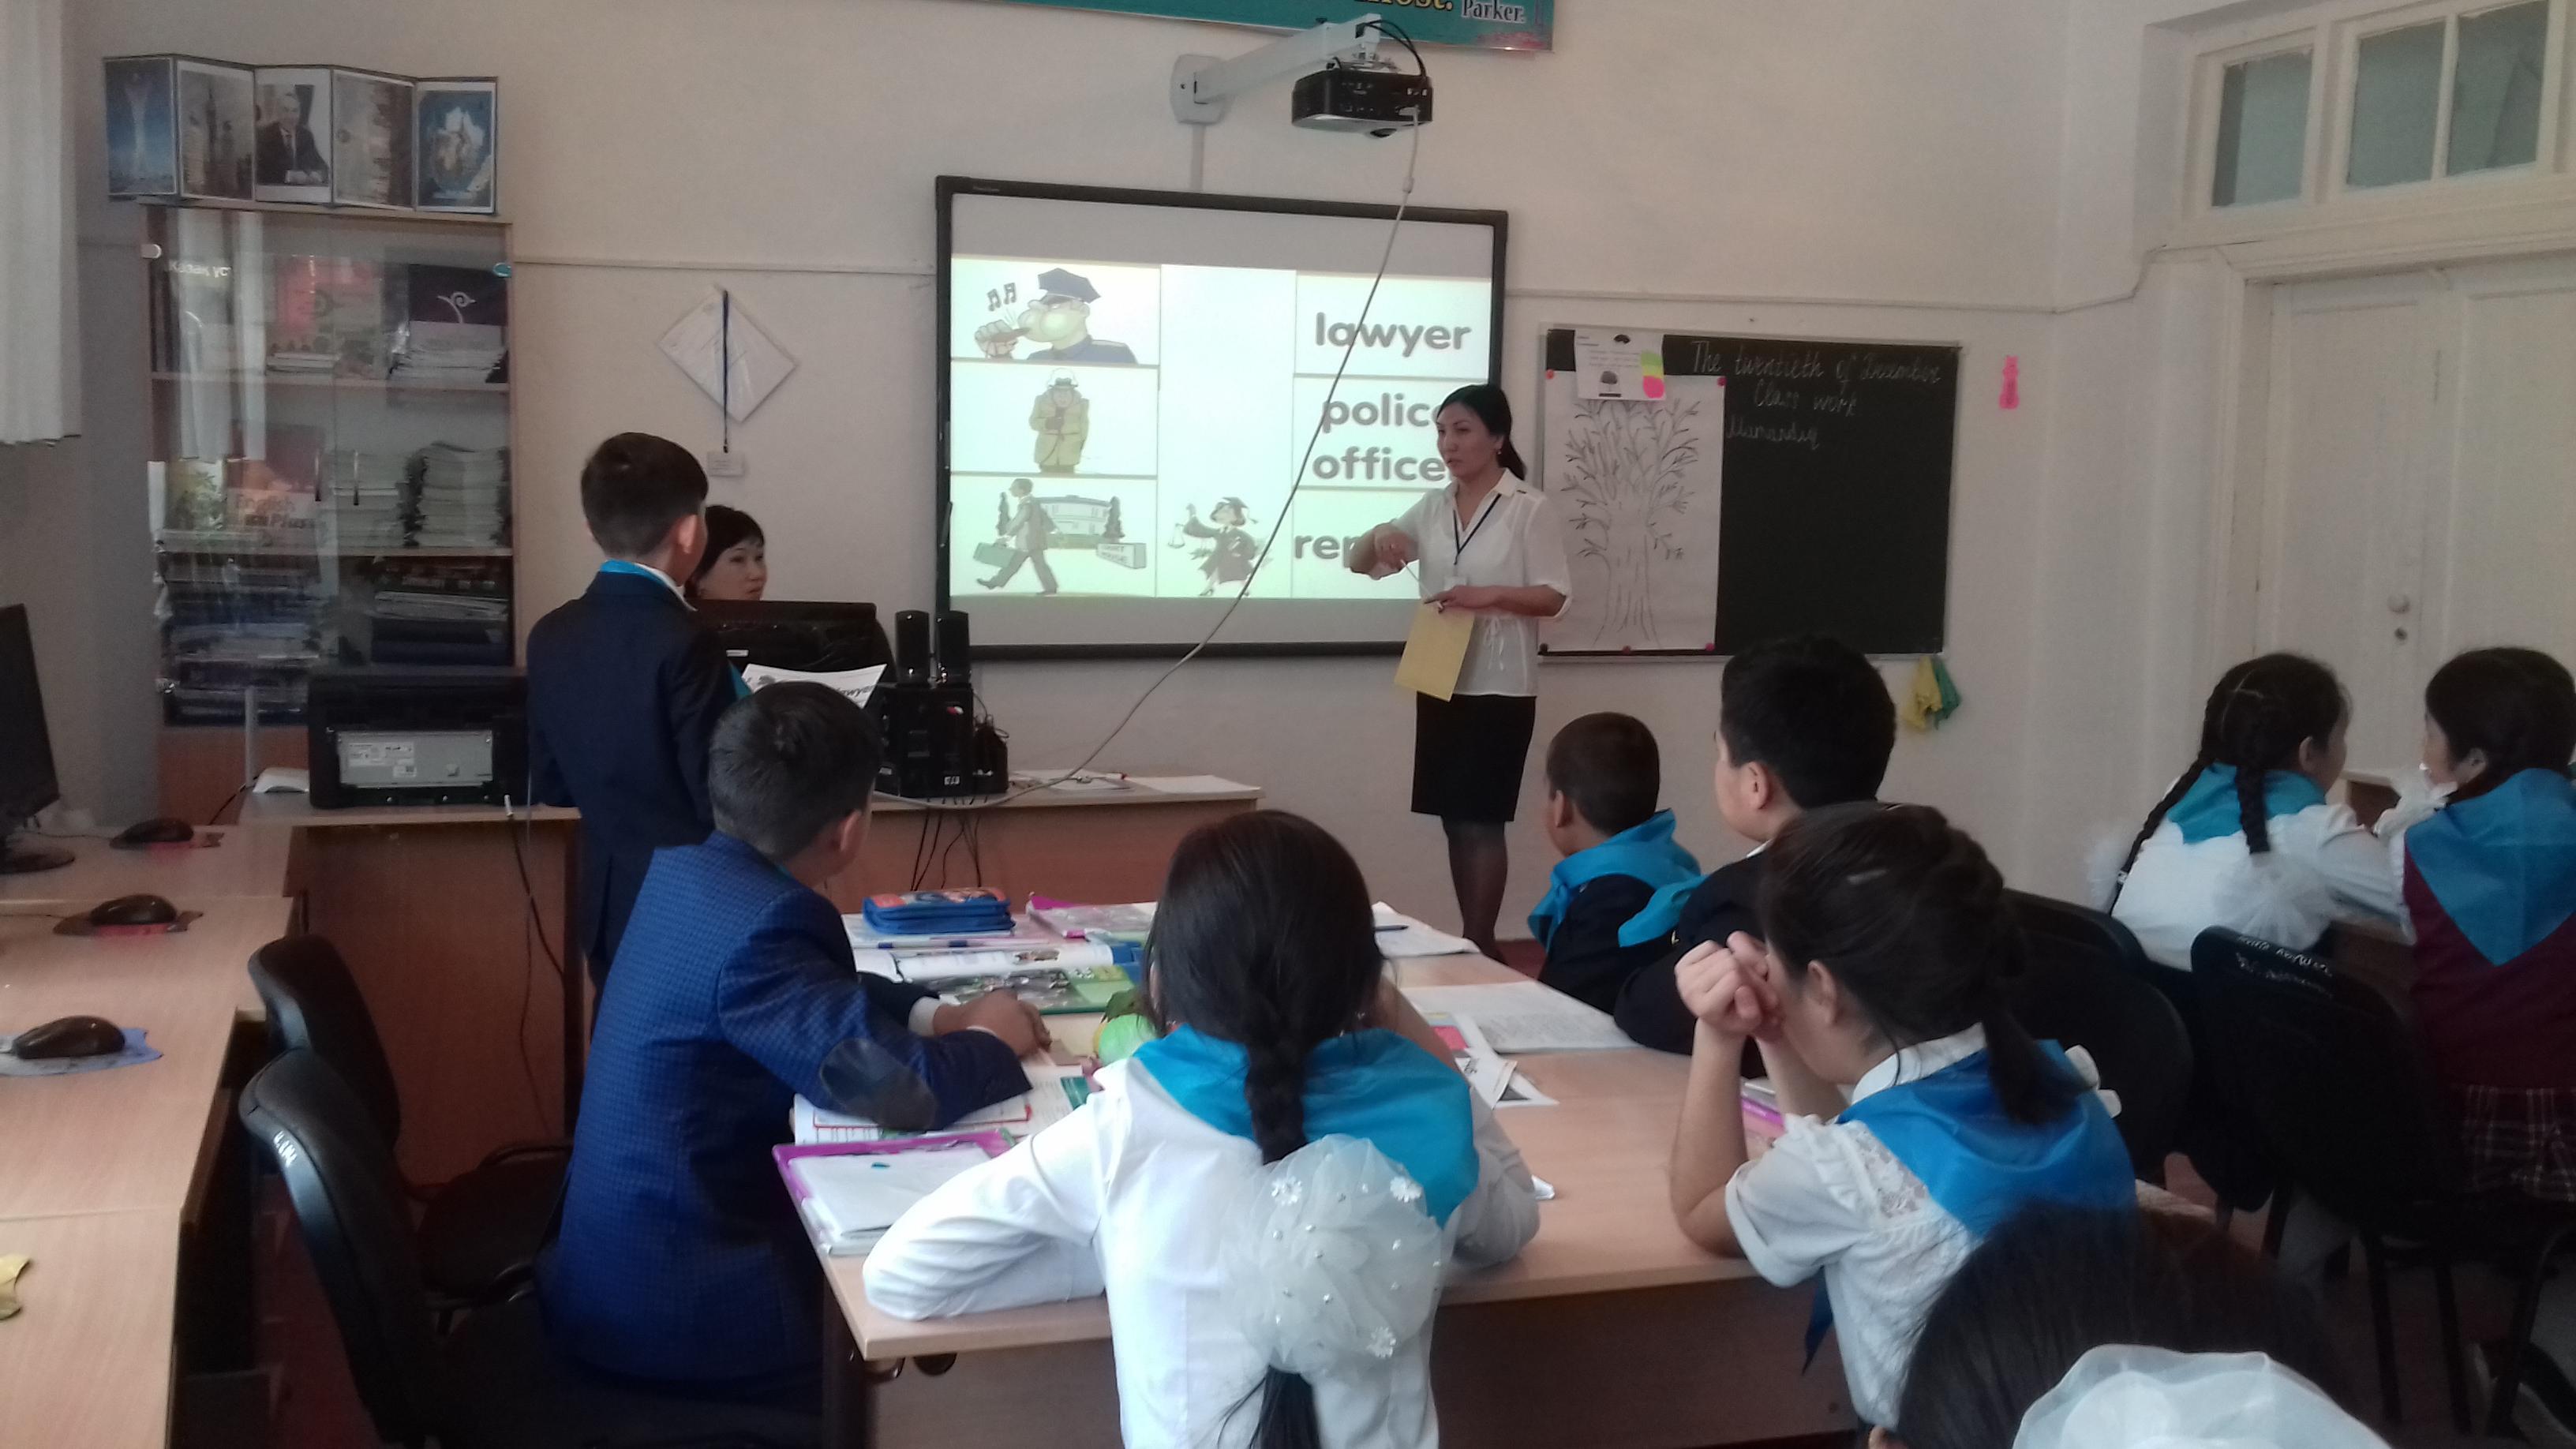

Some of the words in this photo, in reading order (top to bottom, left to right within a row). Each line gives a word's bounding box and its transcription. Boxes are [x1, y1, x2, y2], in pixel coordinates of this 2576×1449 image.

[1316, 312, 1473, 358] lawyer
[1692, 340, 1721, 373] The
[1322, 392, 1442, 434] polic
[1312, 446, 1447, 481] office
